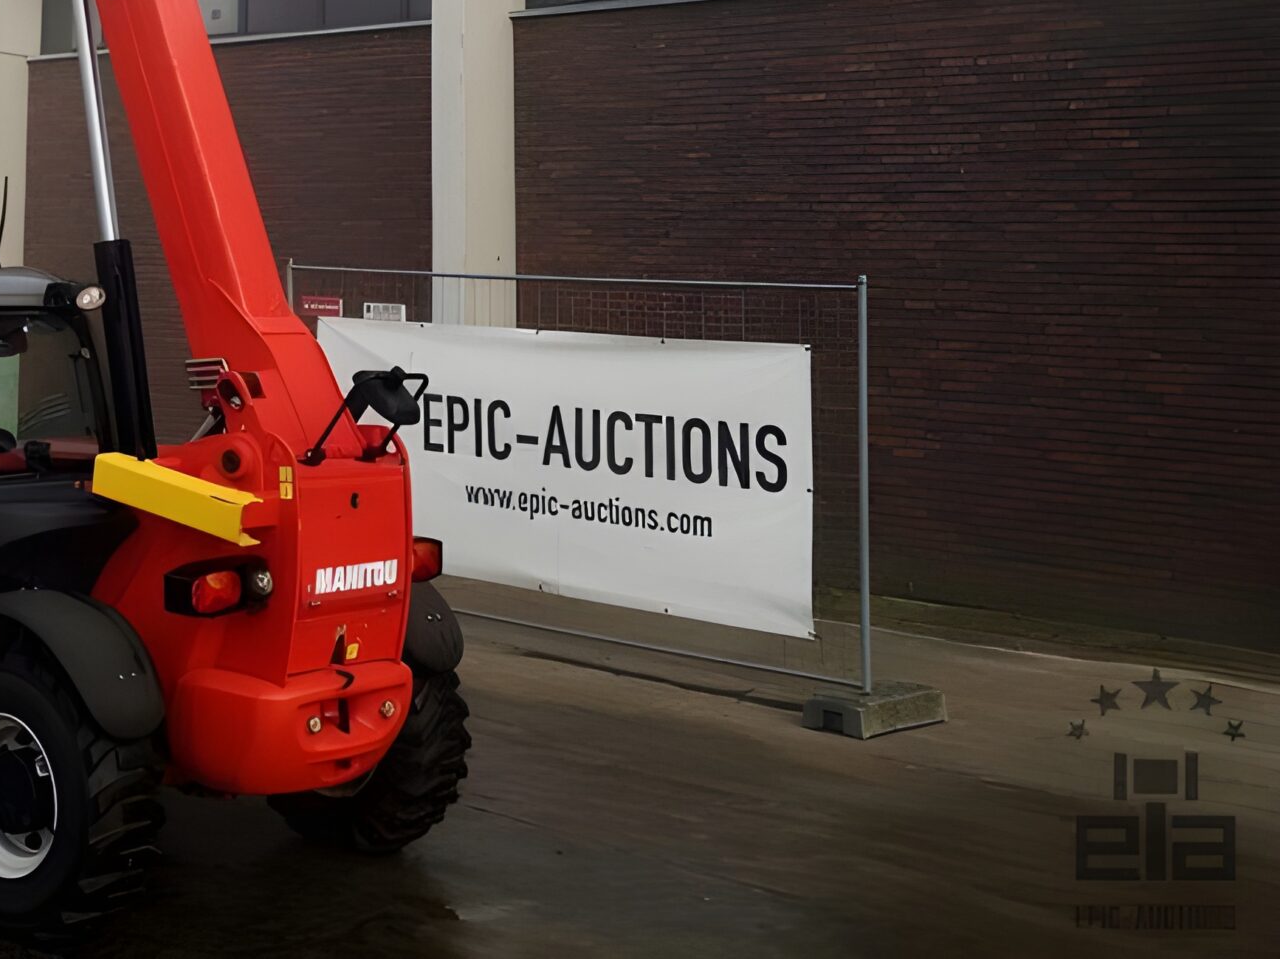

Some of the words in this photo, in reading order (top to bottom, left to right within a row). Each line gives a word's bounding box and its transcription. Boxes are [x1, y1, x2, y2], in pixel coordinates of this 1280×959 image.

[423, 393, 788, 493] EPIC-AUCTIONS
[465, 485, 713, 538] www.epic-auctions.com
[315, 559, 398, 595] MANITOU
